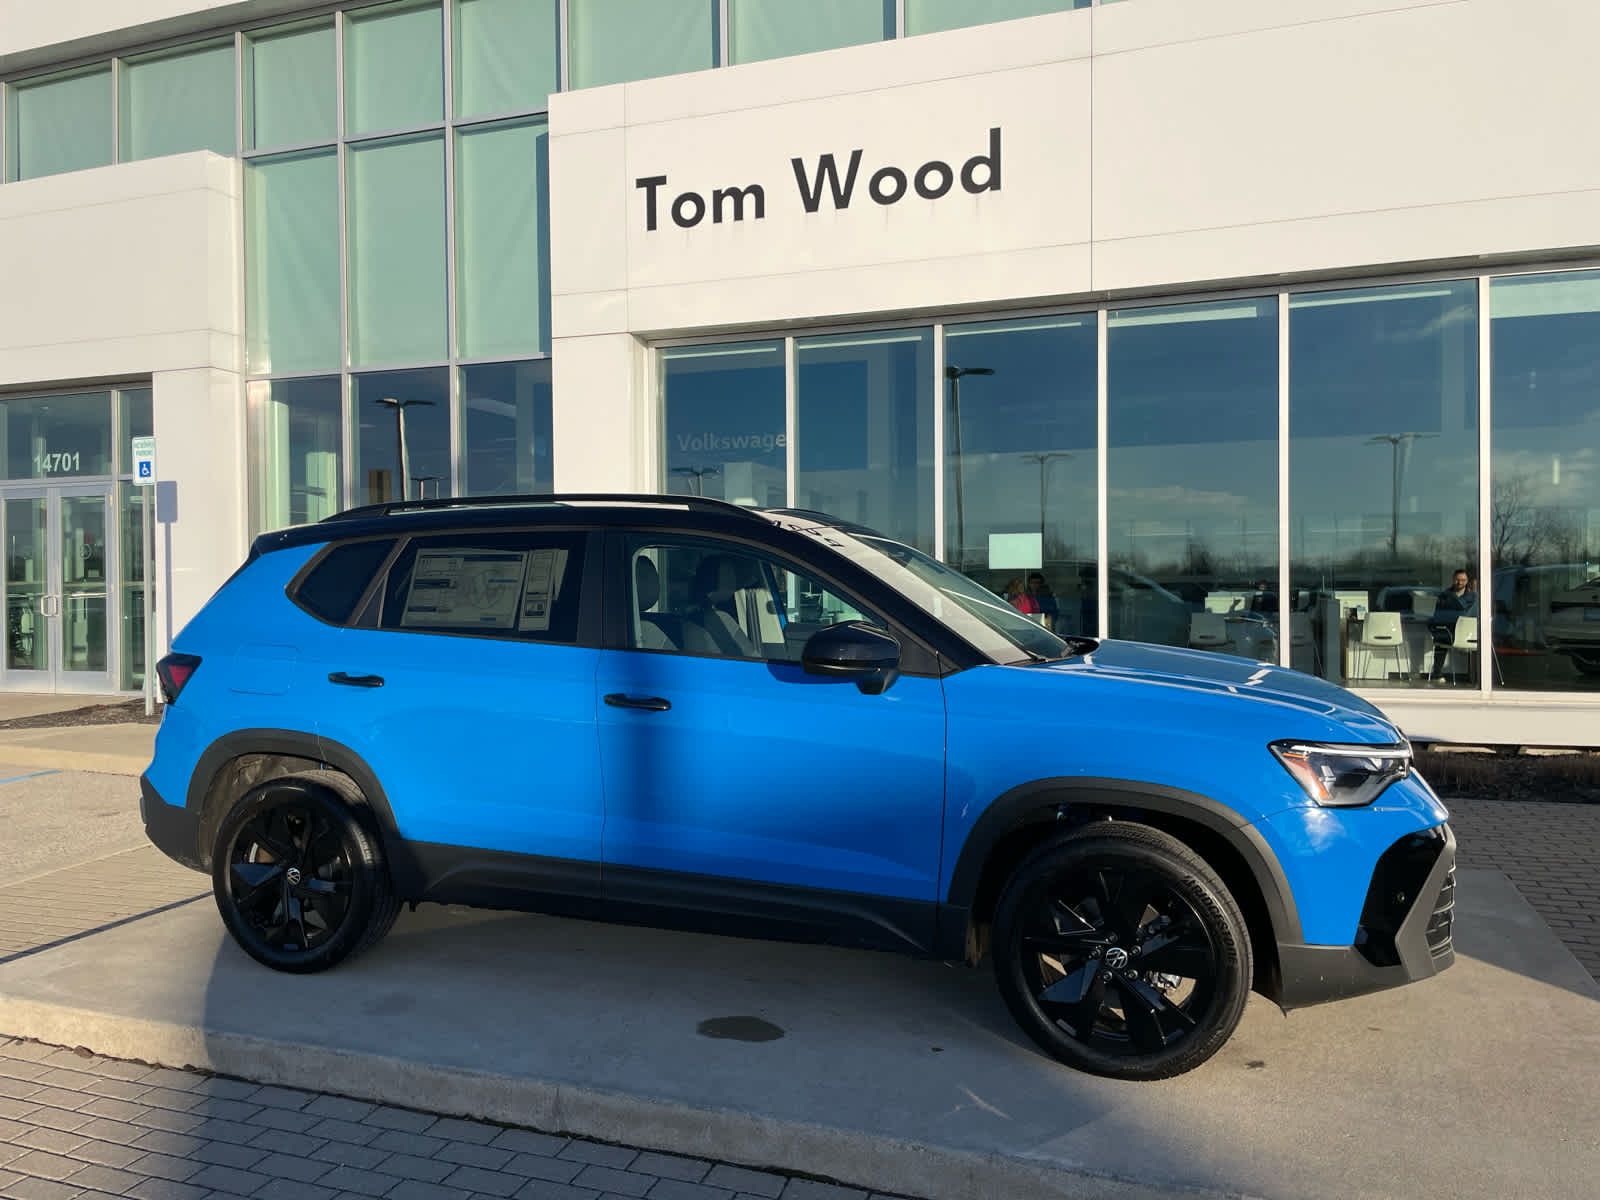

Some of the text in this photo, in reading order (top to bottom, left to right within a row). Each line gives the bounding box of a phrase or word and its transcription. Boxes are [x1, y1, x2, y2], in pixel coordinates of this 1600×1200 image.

[636, 127, 1001, 231] Tom Wood
[677, 432, 787, 452] Volkswage
[33, 452, 80, 472] 14701
